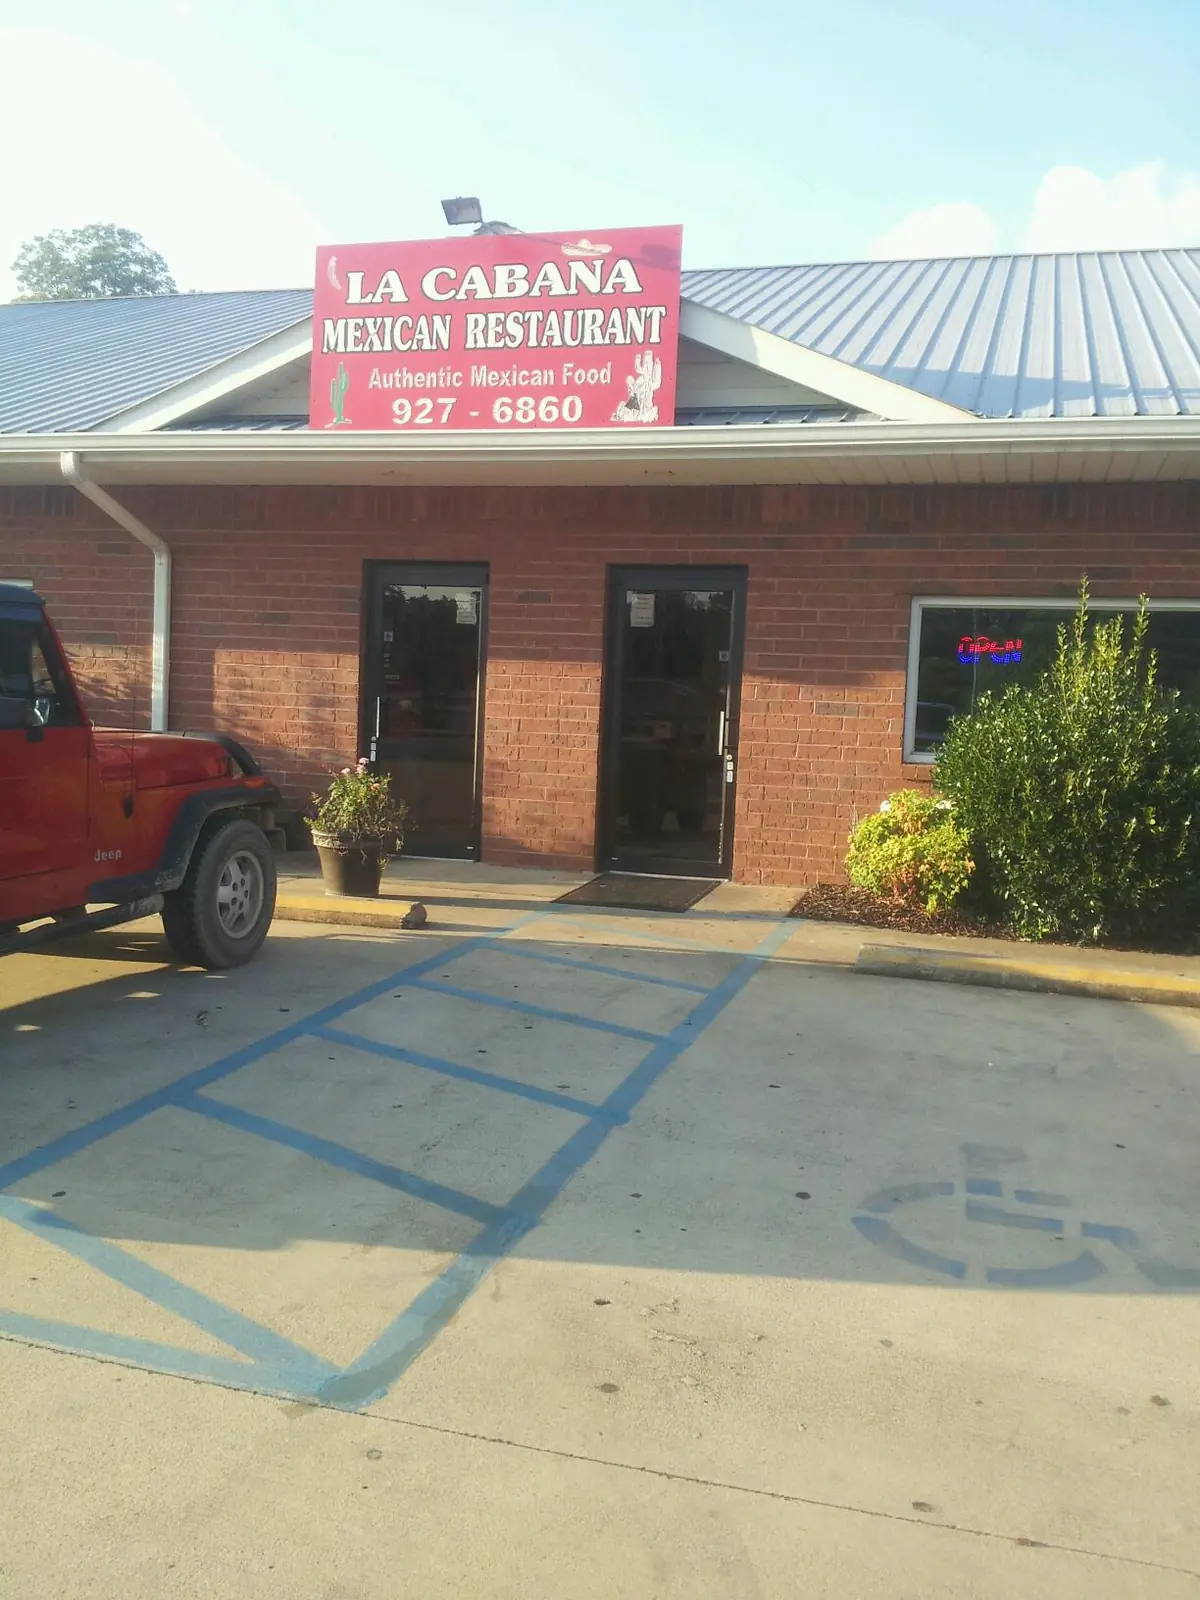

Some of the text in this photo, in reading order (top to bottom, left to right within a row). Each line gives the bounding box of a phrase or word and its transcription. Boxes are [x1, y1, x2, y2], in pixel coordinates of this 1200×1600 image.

[345, 258, 643, 305] LA CABANA
[321, 306, 666, 355] MEXICAN RESTAURANT
[368, 361, 613, 390] Authentic Mexican Food
[391, 397, 457, 425] 927
[491, 395, 584, 424] 6860
[94, 848, 122, 862] Jeep
